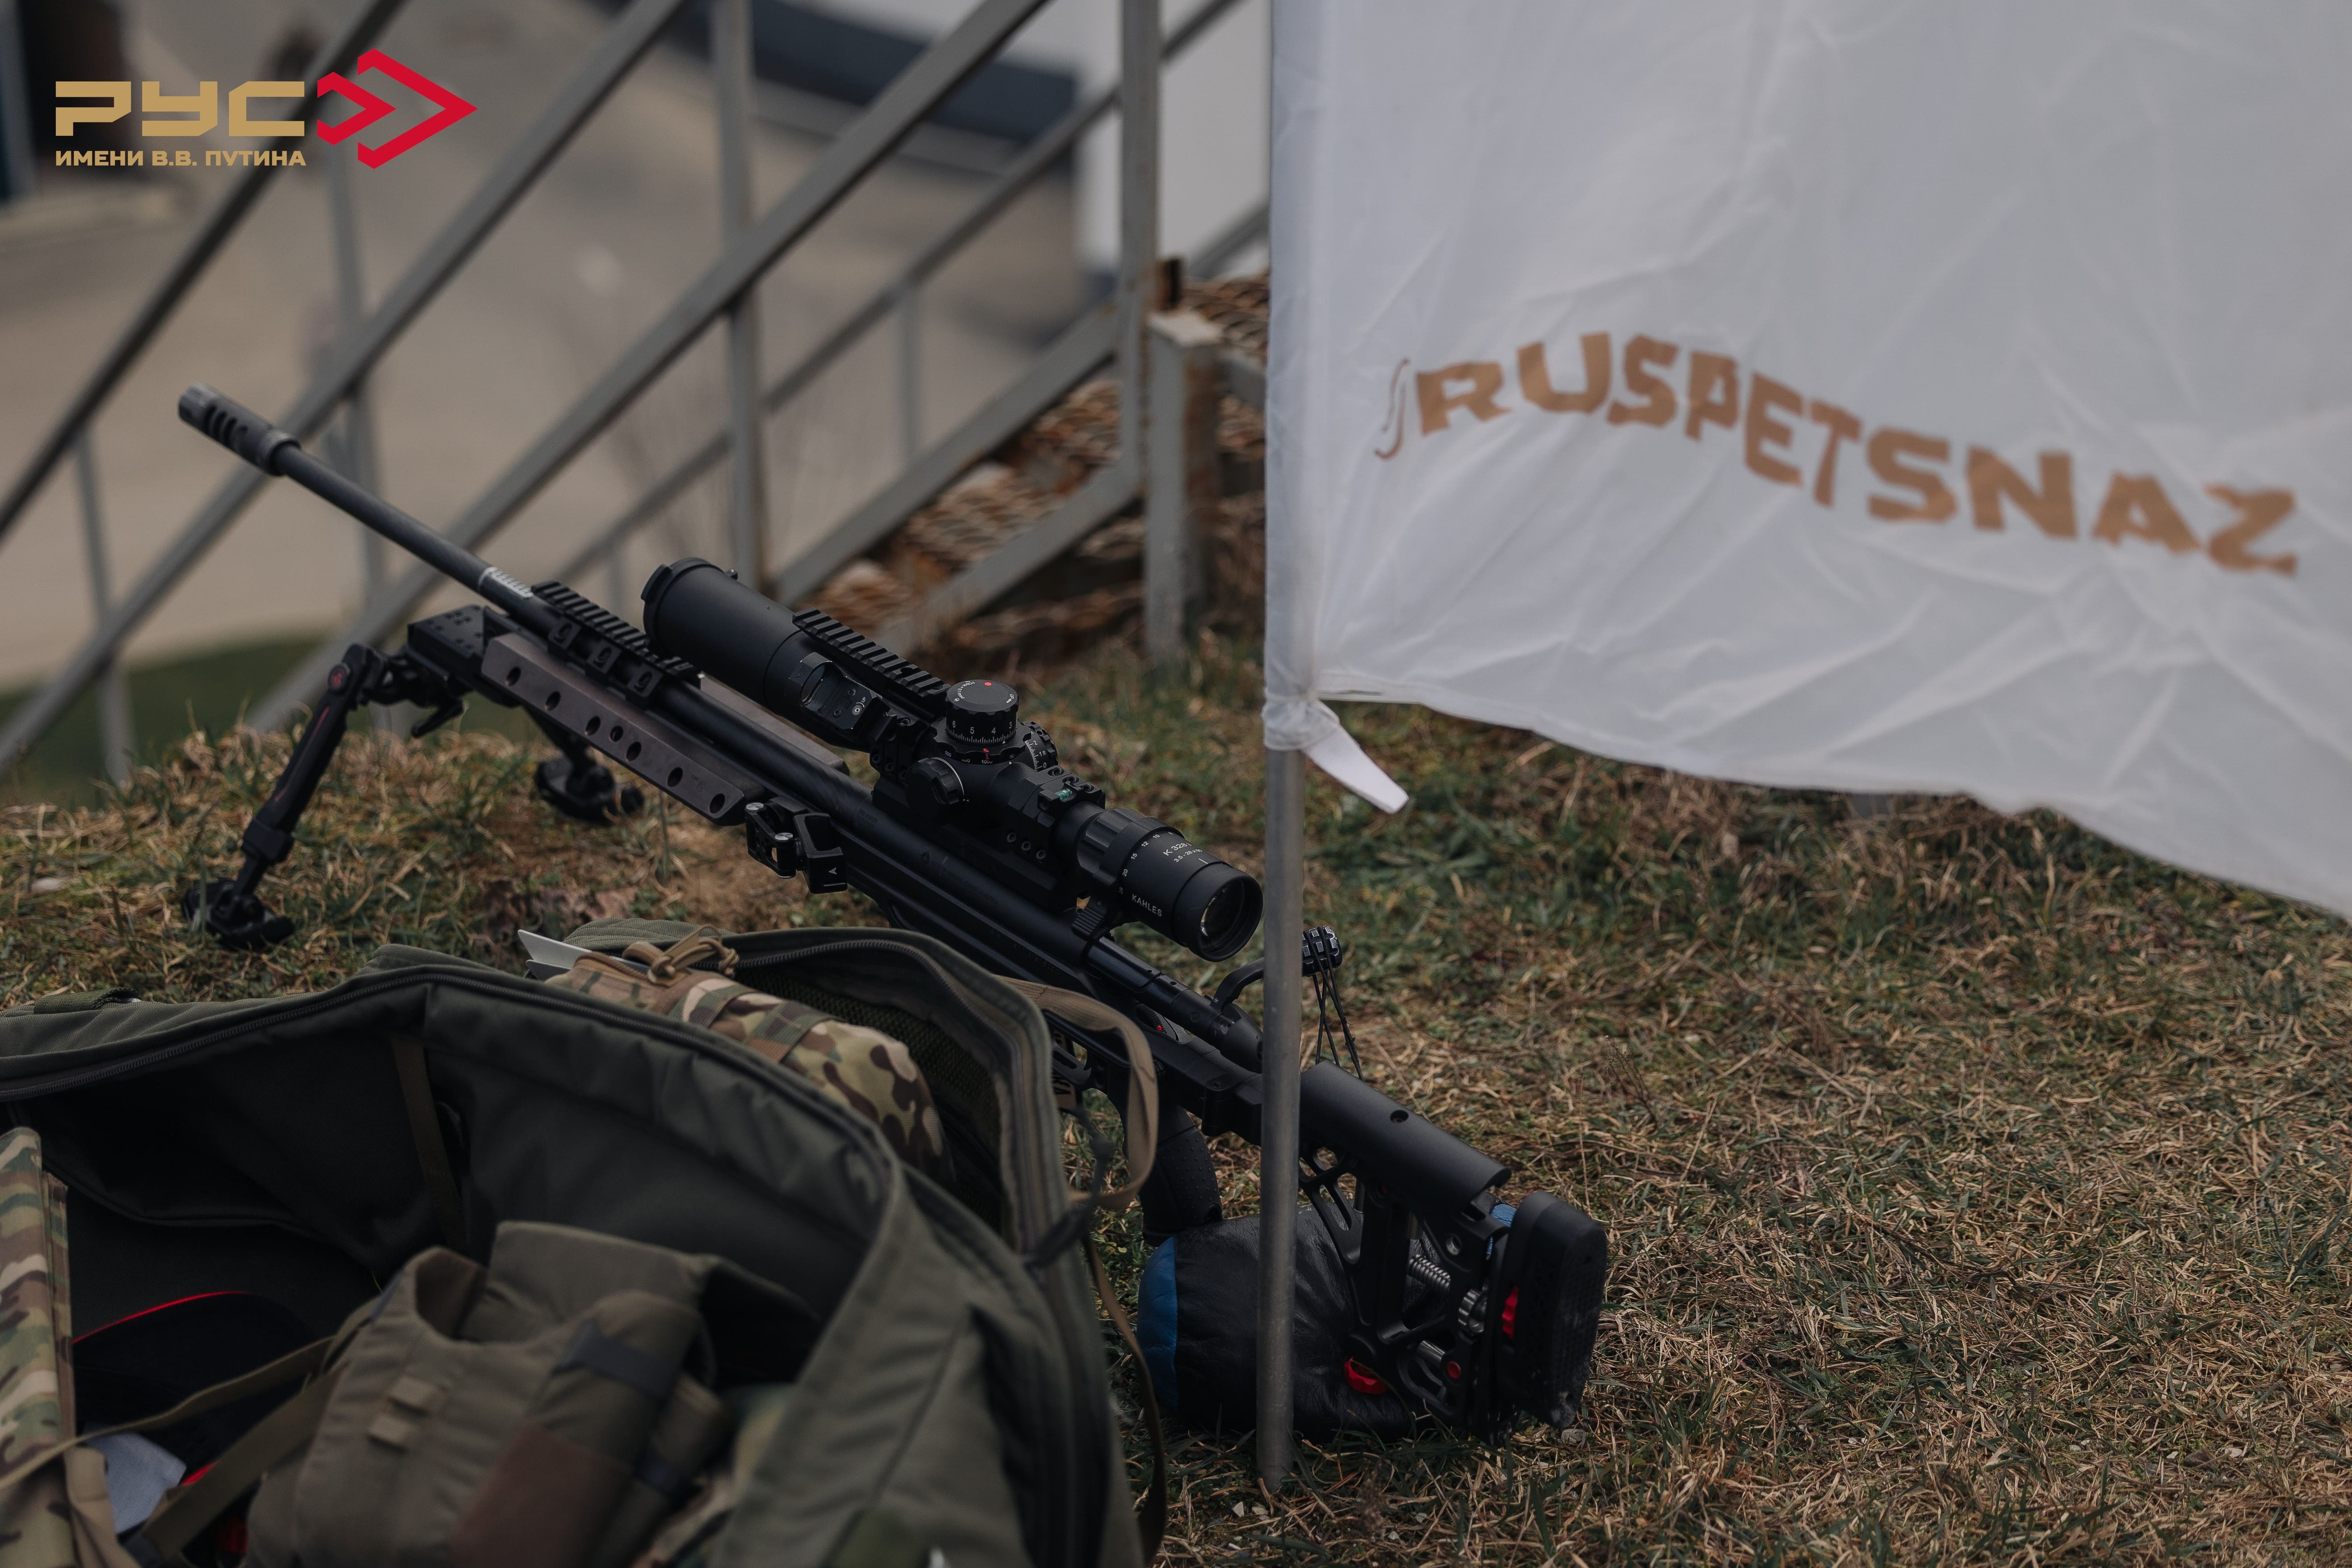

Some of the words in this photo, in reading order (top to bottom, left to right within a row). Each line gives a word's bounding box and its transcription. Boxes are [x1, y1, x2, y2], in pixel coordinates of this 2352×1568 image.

[1415, 332, 2298, 576] RUSPETSNAZ
[952, 720, 956, 728] 6
[1162, 849, 1173, 857] K
[1122, 868, 1128, 877] 20
[1132, 893, 1162, 917] KAHLES
